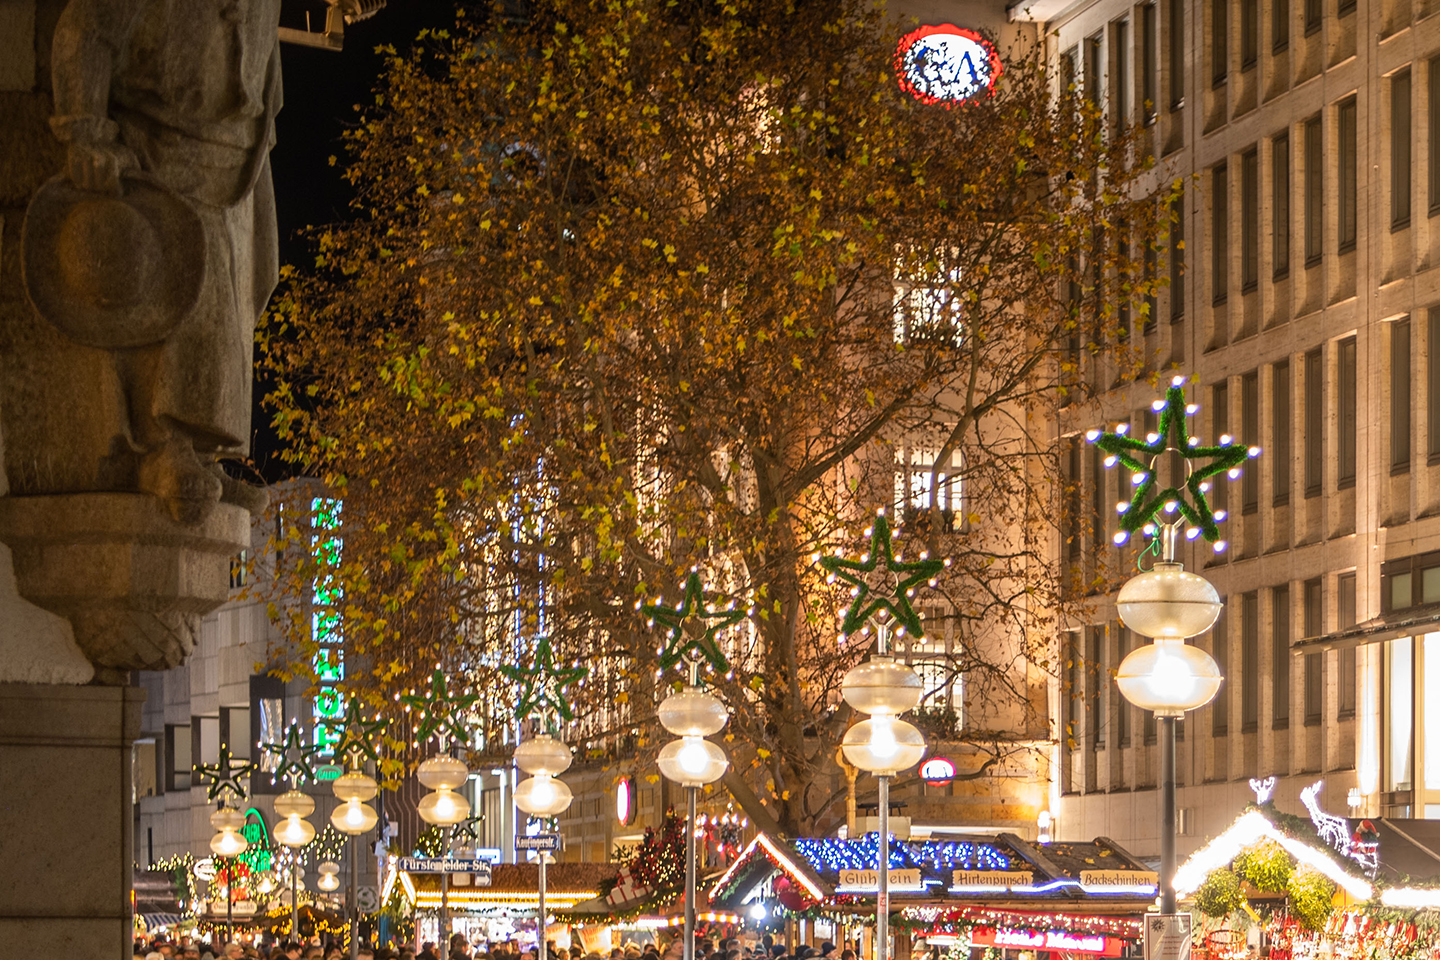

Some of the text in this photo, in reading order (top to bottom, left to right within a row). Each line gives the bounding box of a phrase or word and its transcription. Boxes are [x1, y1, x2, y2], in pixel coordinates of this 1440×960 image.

[516, 836, 555, 850] Kaufingerstr.
[845, 872, 911, 885] Glühein
[958, 872, 1029, 887] Hirtenpunsch
[1084, 872, 1151, 887] Backschinken
